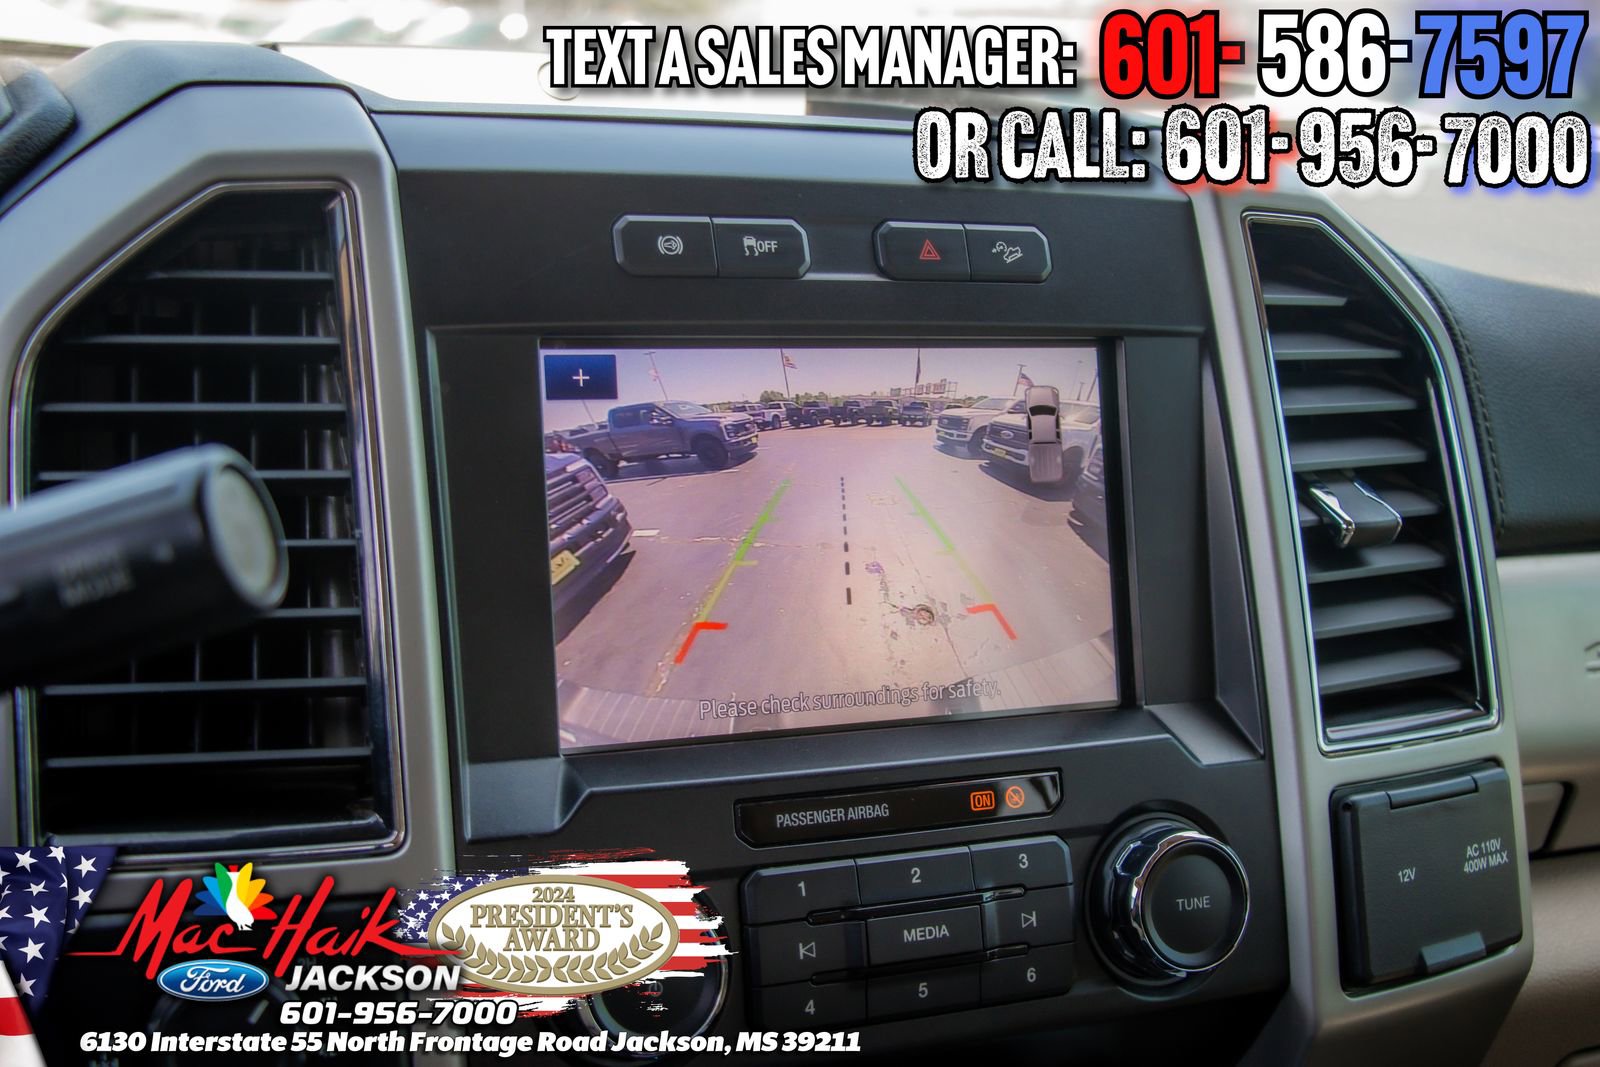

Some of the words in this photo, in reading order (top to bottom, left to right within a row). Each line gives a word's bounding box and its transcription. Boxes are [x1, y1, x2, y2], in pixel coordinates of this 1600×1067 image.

[757, 240, 778, 253] OFF
[699, 698, 758, 721] Please
[760, 692, 810, 714] check
[812, 683, 919, 711] surroundings
[921, 681, 945, 702] for
[948, 676, 1003, 700] safety.
[775, 807, 847, 829] PASSENGER
[846, 803, 890, 821] AIRBAG
[974, 794, 990, 807] ON
[1465, 845, 1480, 859] AC
[1480, 837, 1502, 854] 110V
[1018, 853, 1029, 869] 3
[1462, 857, 1488, 873] 400W
[1488, 851, 1509, 868] MAX
[910, 867, 921, 884] 2
[1397, 867, 1416, 883] 12V
[797, 881, 807, 897] 1
[1175, 895, 1212, 912] TUNE
[903, 924, 950, 942] MEDIA
[1026, 967, 1038, 984] 6
[917, 983, 929, 999] 5
[804, 999, 816, 1015] 4
